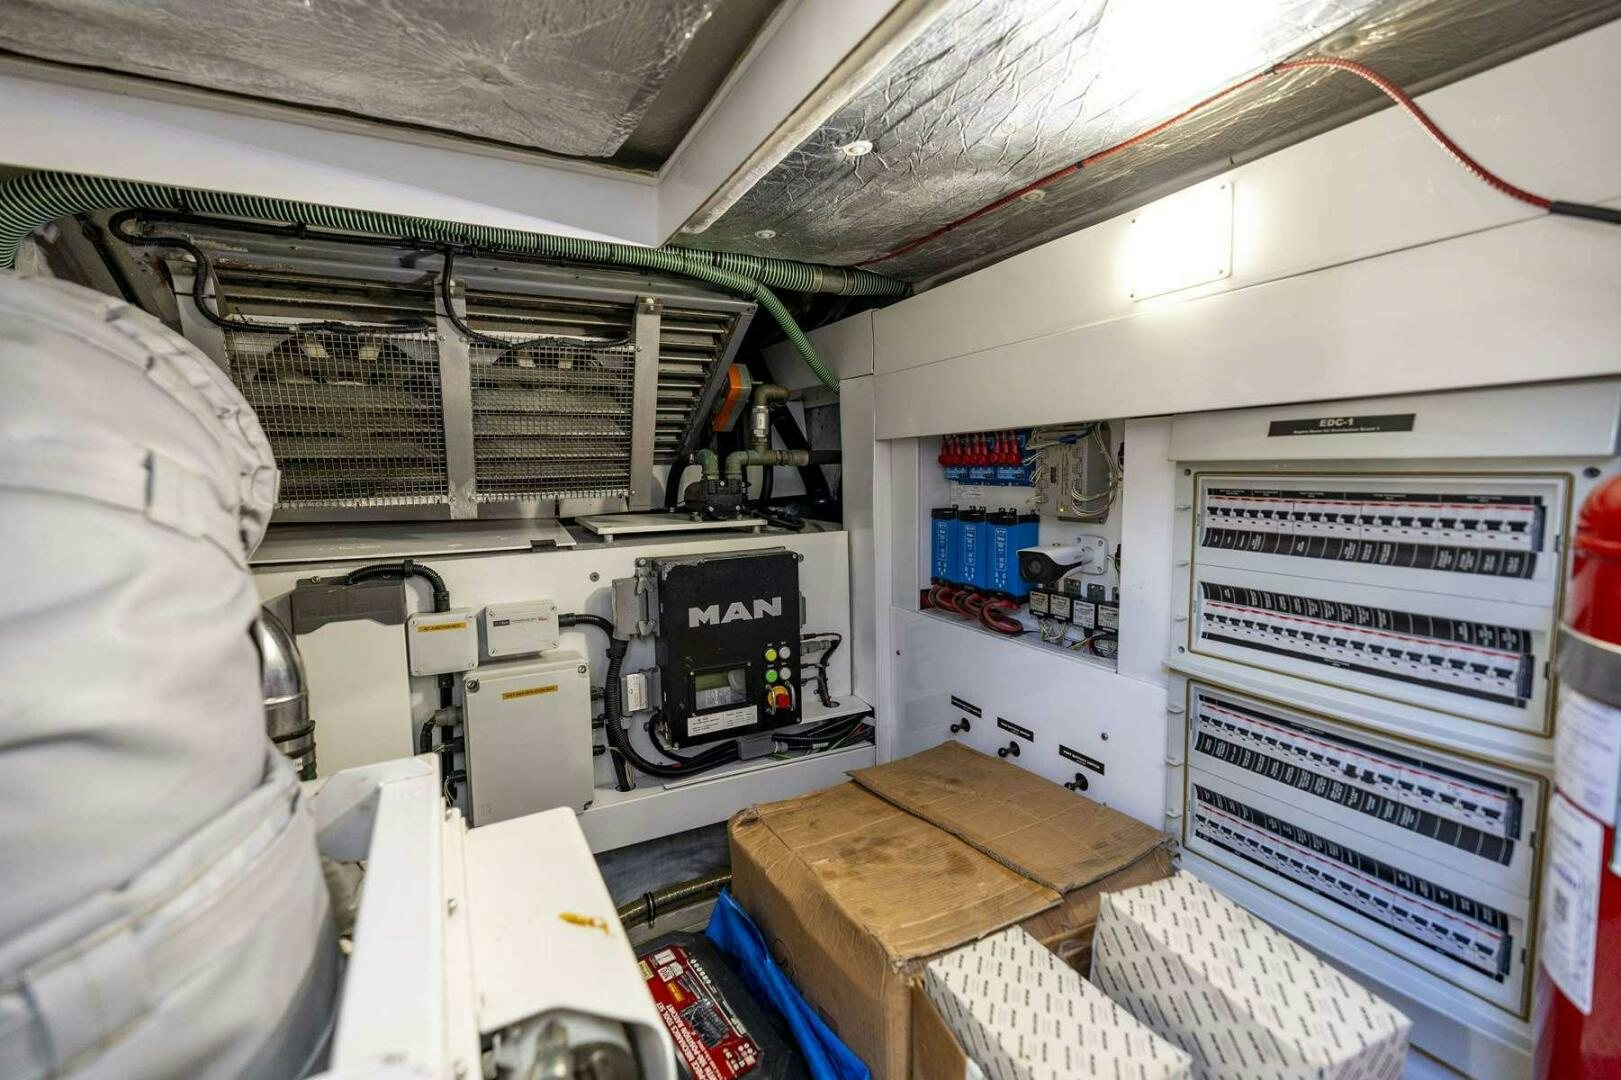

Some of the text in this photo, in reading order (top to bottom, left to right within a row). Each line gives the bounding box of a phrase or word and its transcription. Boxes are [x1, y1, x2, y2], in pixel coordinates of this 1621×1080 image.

[1319, 418, 1354, 427] EDC-1
[689, 596, 782, 628] MAN
[663, 1010, 675, 1026] TOOL
